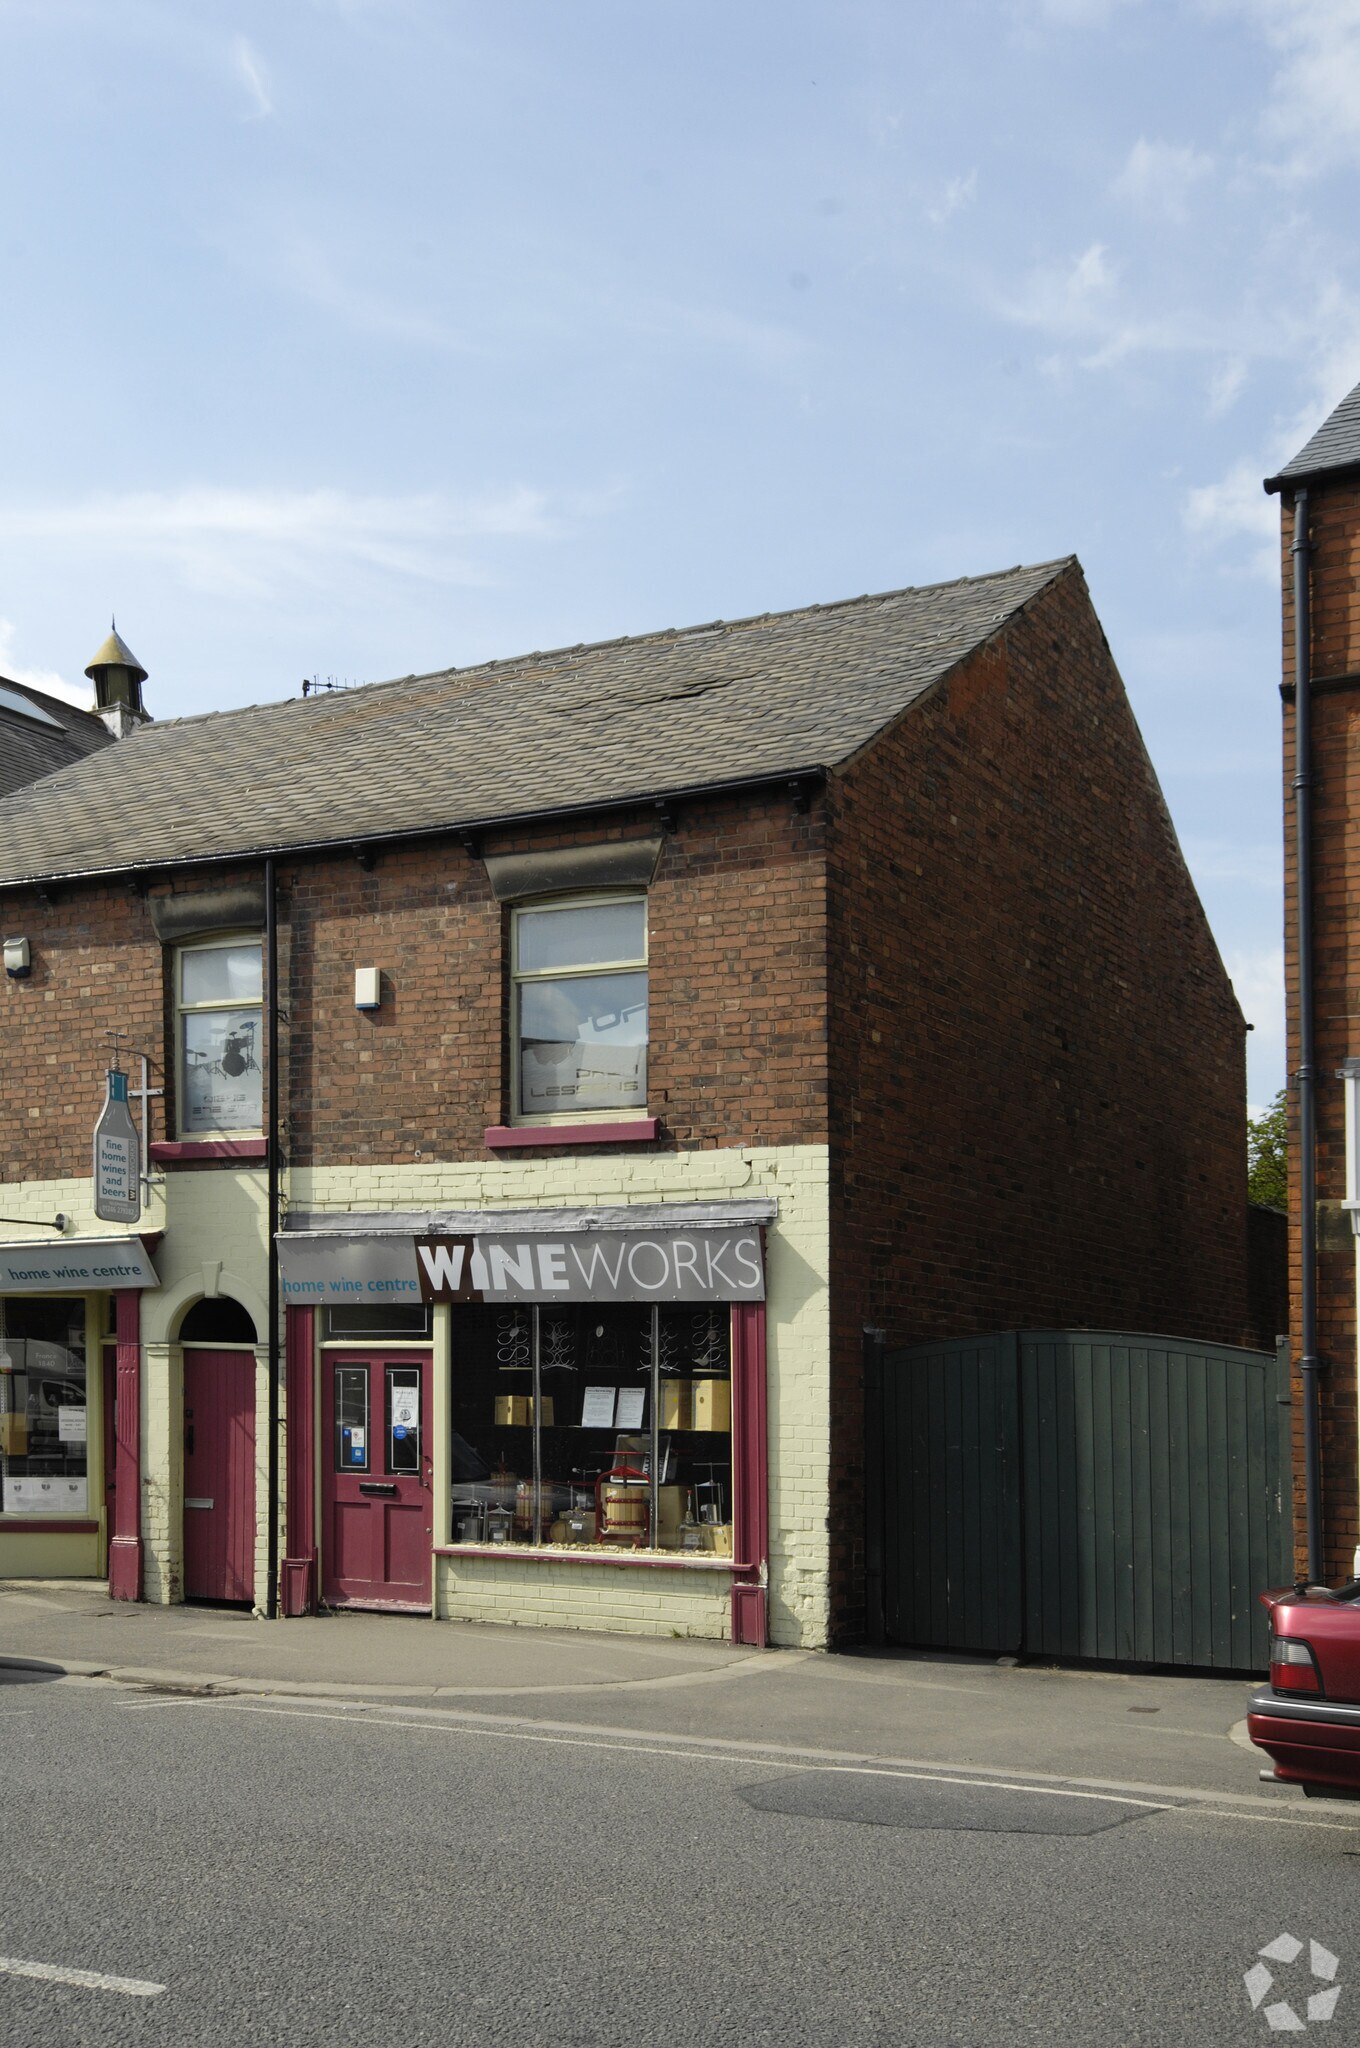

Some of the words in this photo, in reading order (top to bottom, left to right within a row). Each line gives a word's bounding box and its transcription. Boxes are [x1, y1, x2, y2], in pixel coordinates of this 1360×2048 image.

[105, 1140, 122, 1151] fine
[102, 1150, 127, 1163] home
[101, 1164, 127, 1175] wines
[106, 1177, 122, 1186] and
[102, 1185, 127, 1198] beers
[8, 1268, 51, 1281] home
[53, 1266, 90, 1279] wine
[92, 1265, 142, 1278] centre
[282, 1278, 325, 1294] home
[331, 1276, 363, 1292] wine
[367, 1278, 417, 1292] centre
